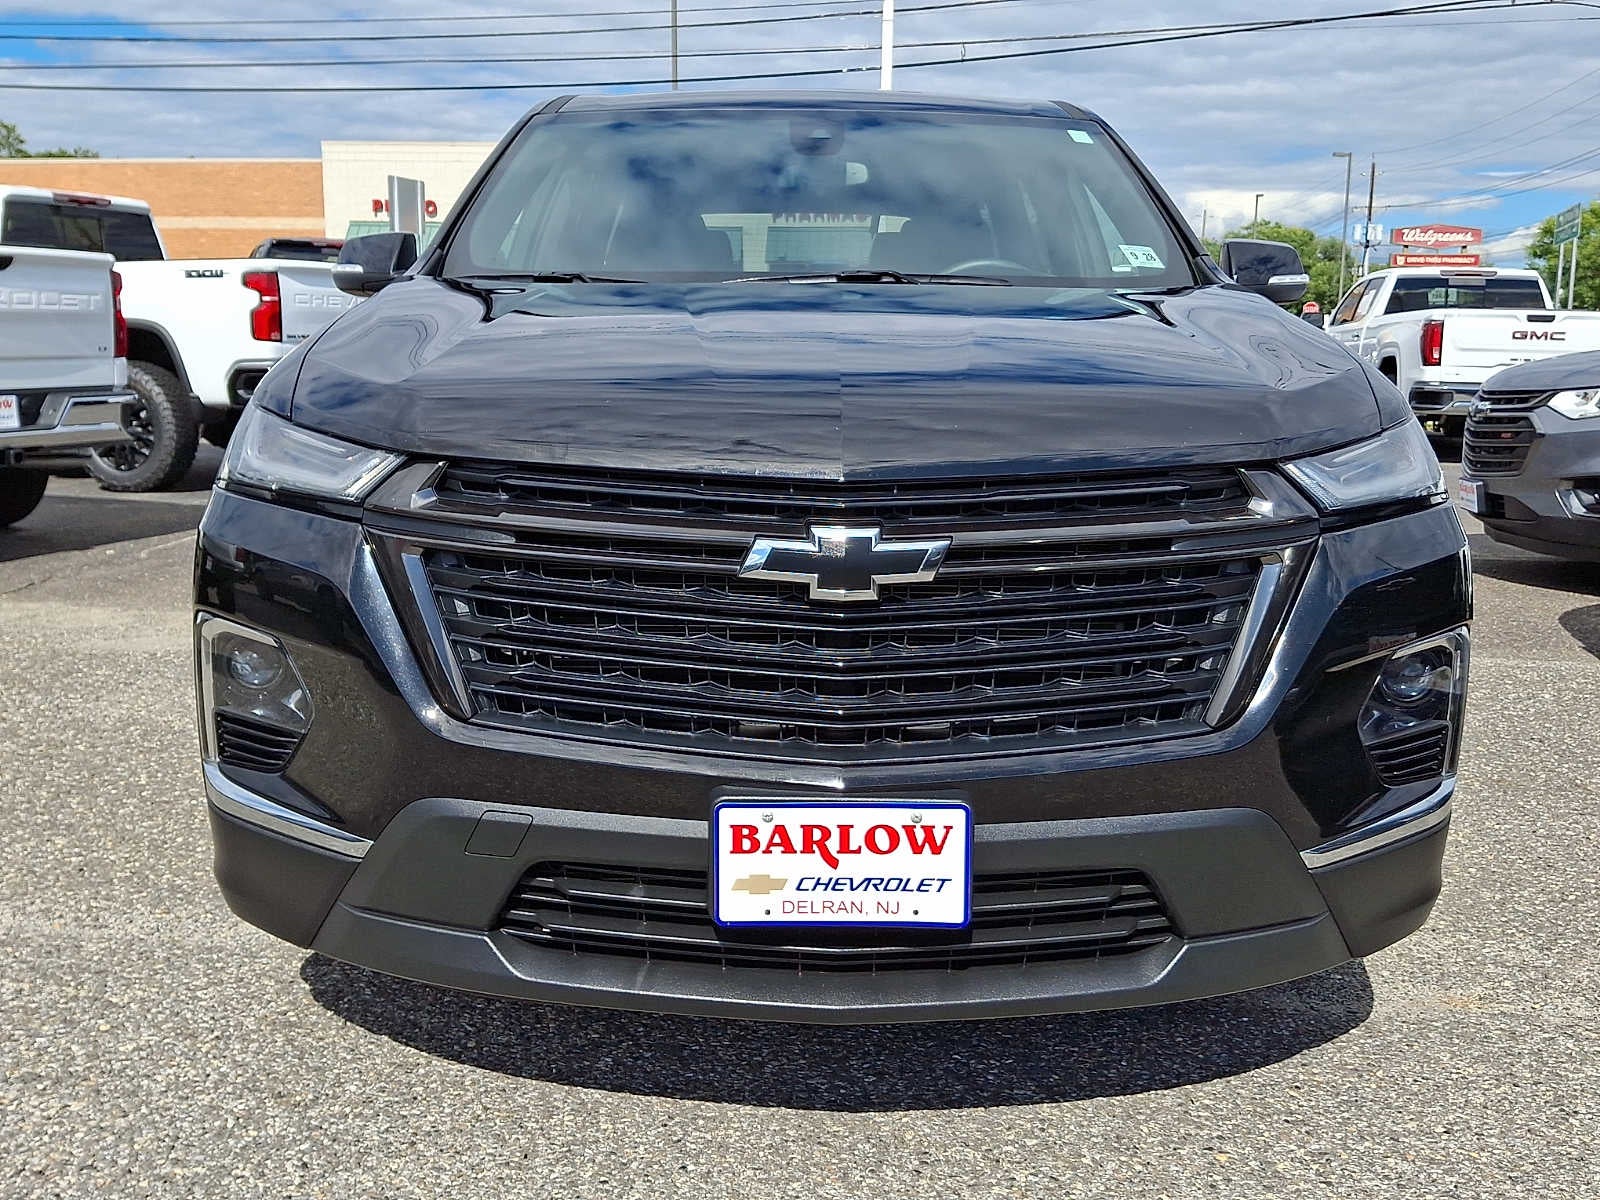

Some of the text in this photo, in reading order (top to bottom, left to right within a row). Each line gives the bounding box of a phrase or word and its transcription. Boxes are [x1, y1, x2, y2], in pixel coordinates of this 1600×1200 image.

[1402, 228, 1474, 245] Walgreens
[1511, 330, 1566, 341] GMC
[729, 824, 953, 870] BARLOW
[795, 877, 953, 893] CHEVROLET
[782, 900, 900, 916] DELRAN, NJ
